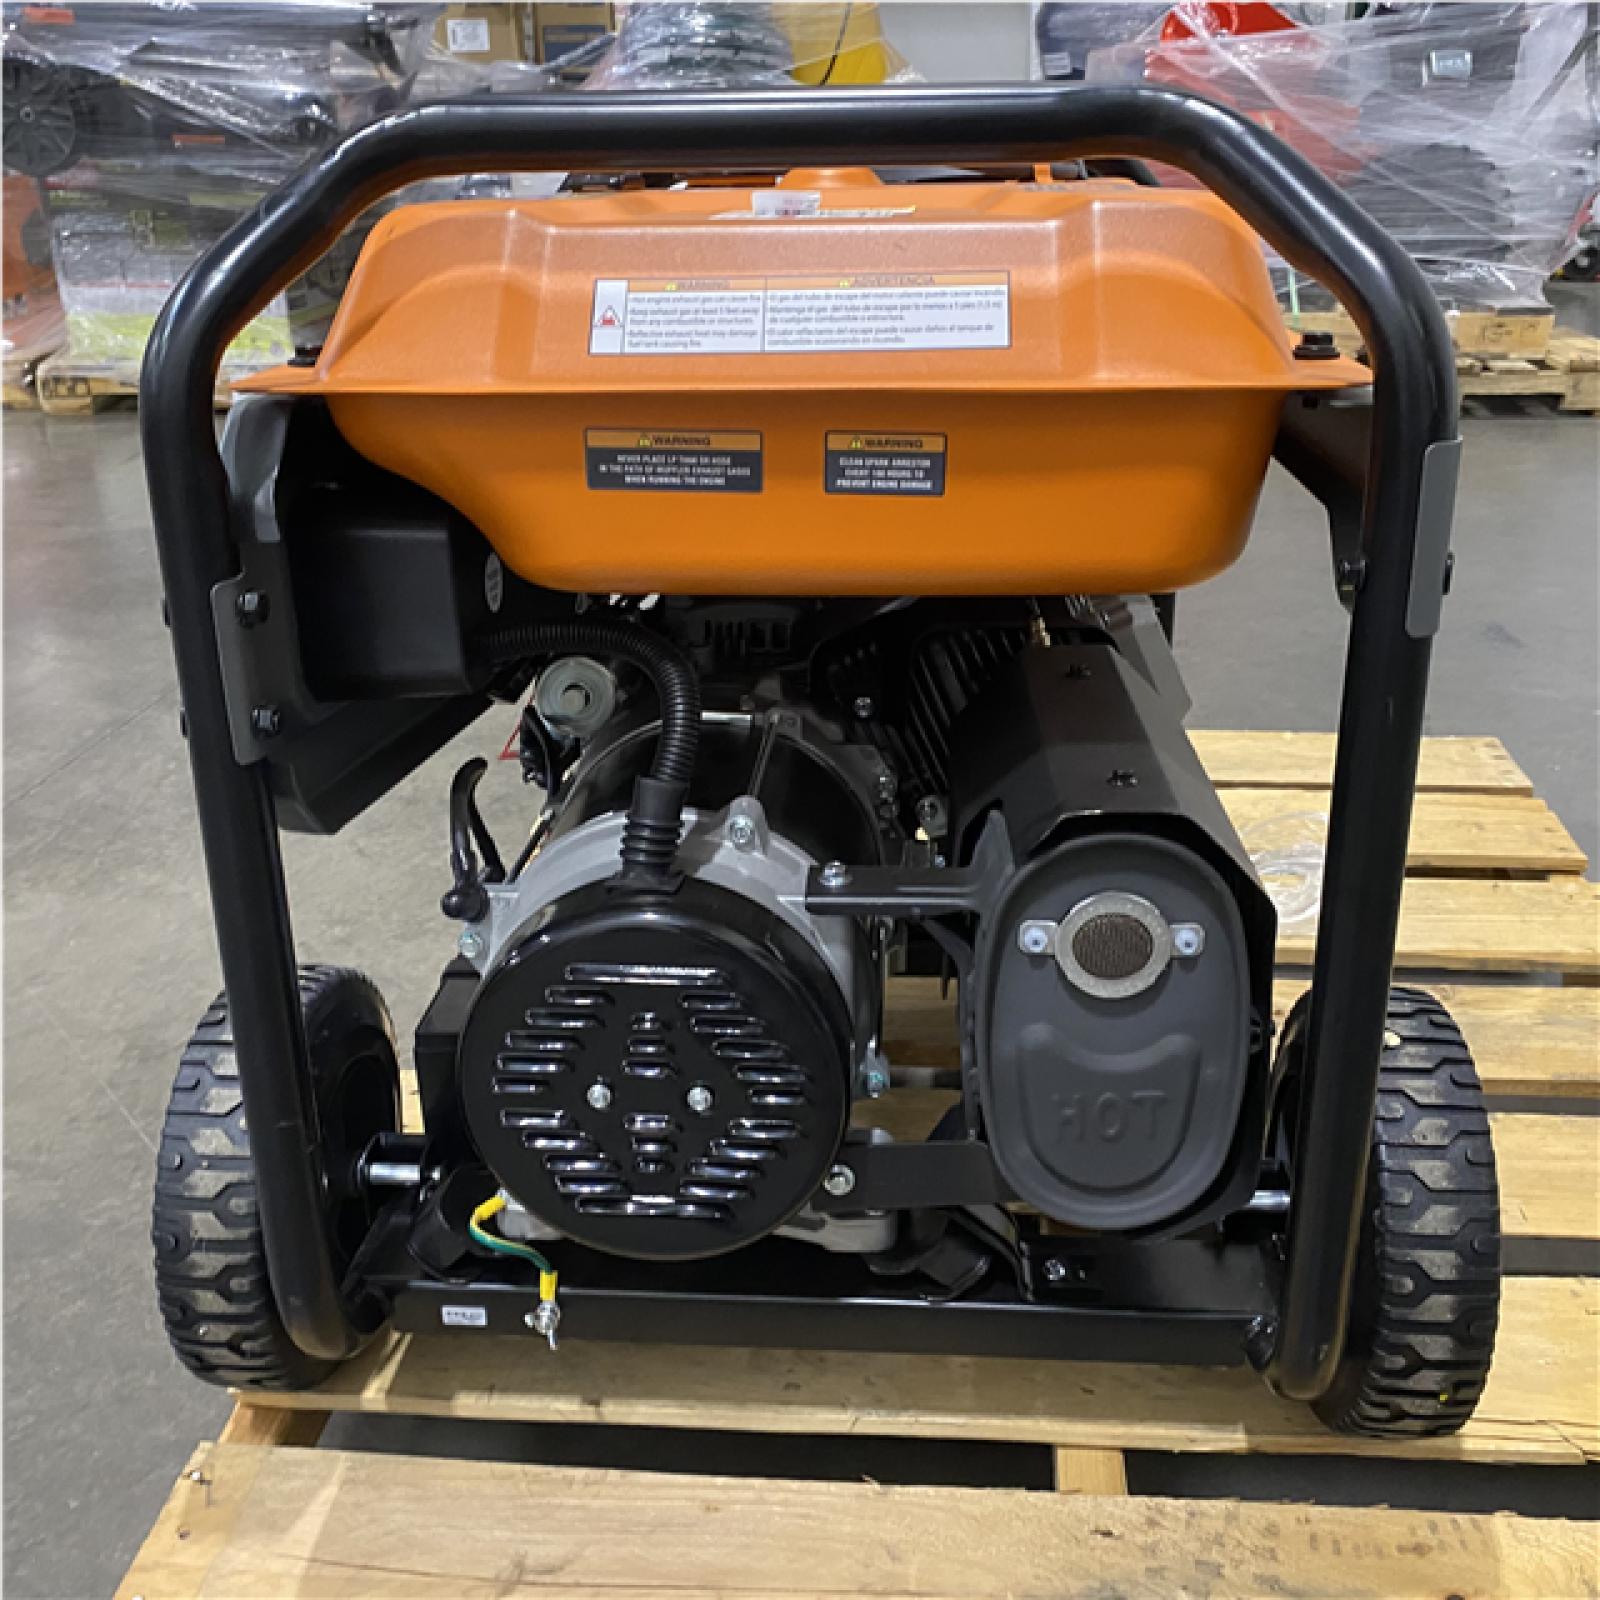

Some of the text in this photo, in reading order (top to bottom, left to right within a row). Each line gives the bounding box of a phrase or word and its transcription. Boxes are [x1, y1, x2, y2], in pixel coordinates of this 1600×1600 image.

[677, 280, 730, 290] WARNING
[652, 435, 711, 447] WARNING
[864, 438, 924, 449] WARNING
[1049, 1089, 1169, 1143] HOT
